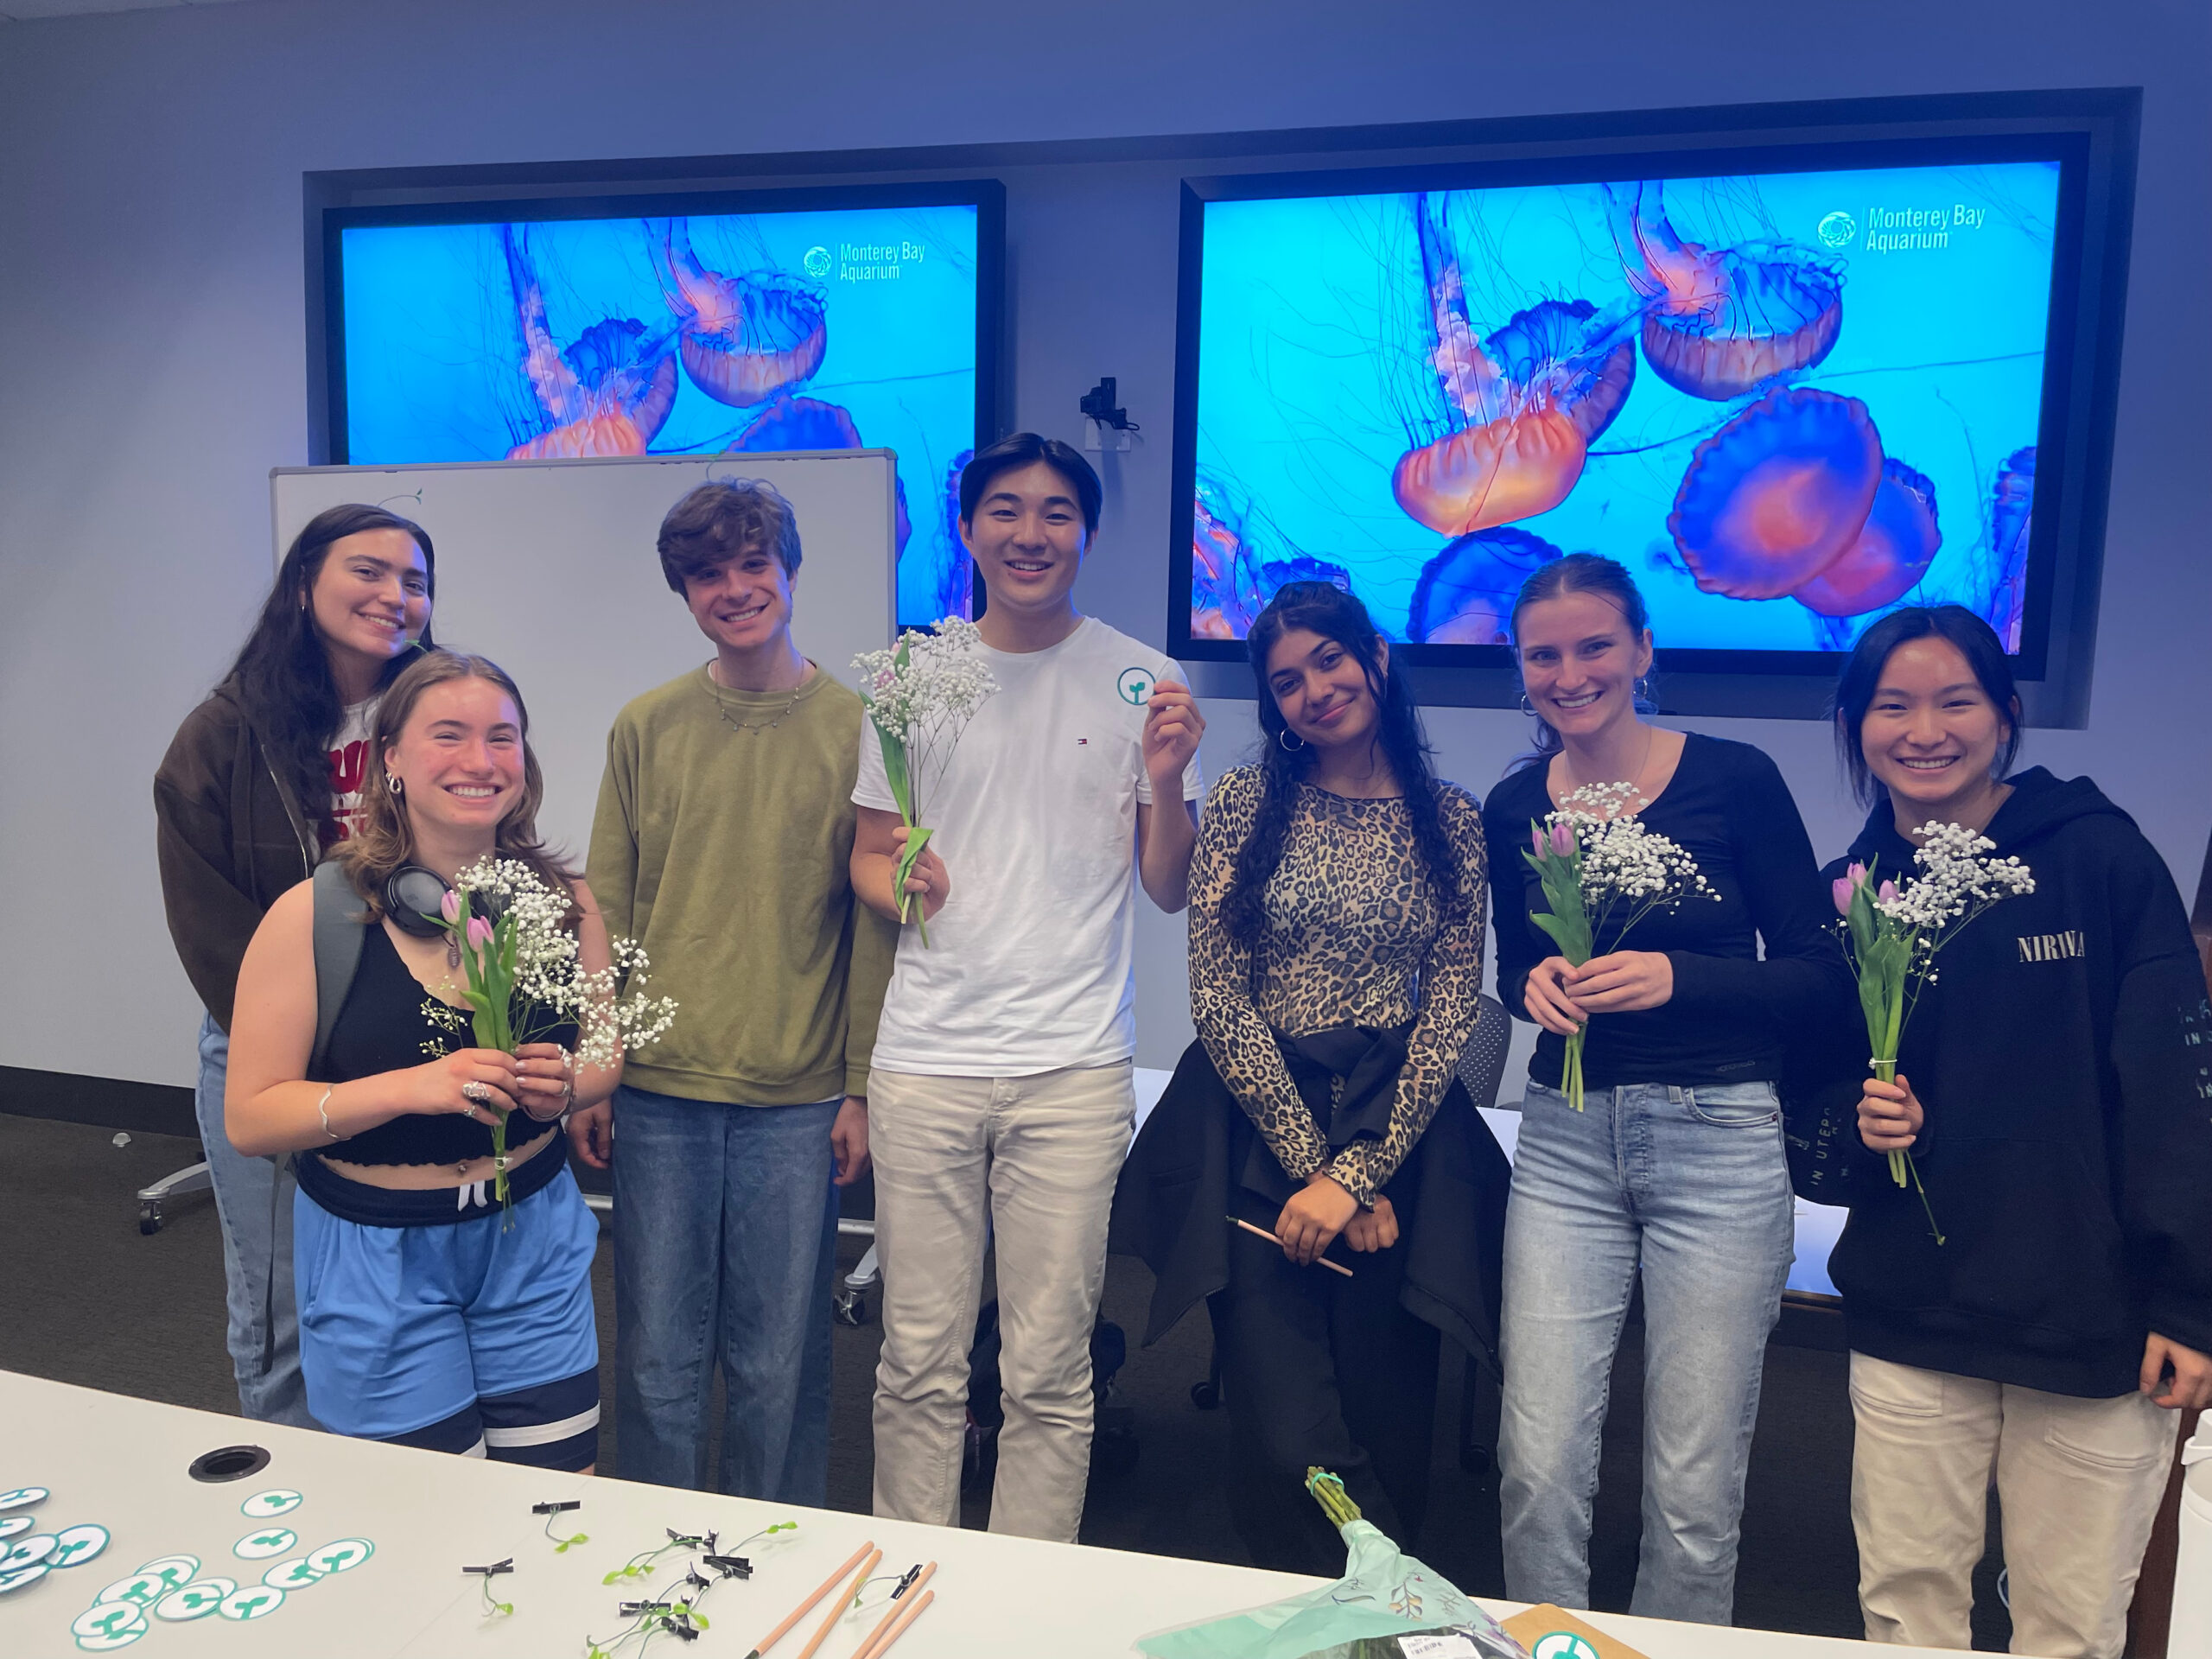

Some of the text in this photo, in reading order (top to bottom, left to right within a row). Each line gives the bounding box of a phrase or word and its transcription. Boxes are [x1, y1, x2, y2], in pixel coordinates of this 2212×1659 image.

[1868, 204, 1986, 231] Monterey Bay
[840, 241, 925, 264] Monterey Bay
[1866, 227, 1949, 255] Aquarium
[840, 262, 900, 283] Aquarium
